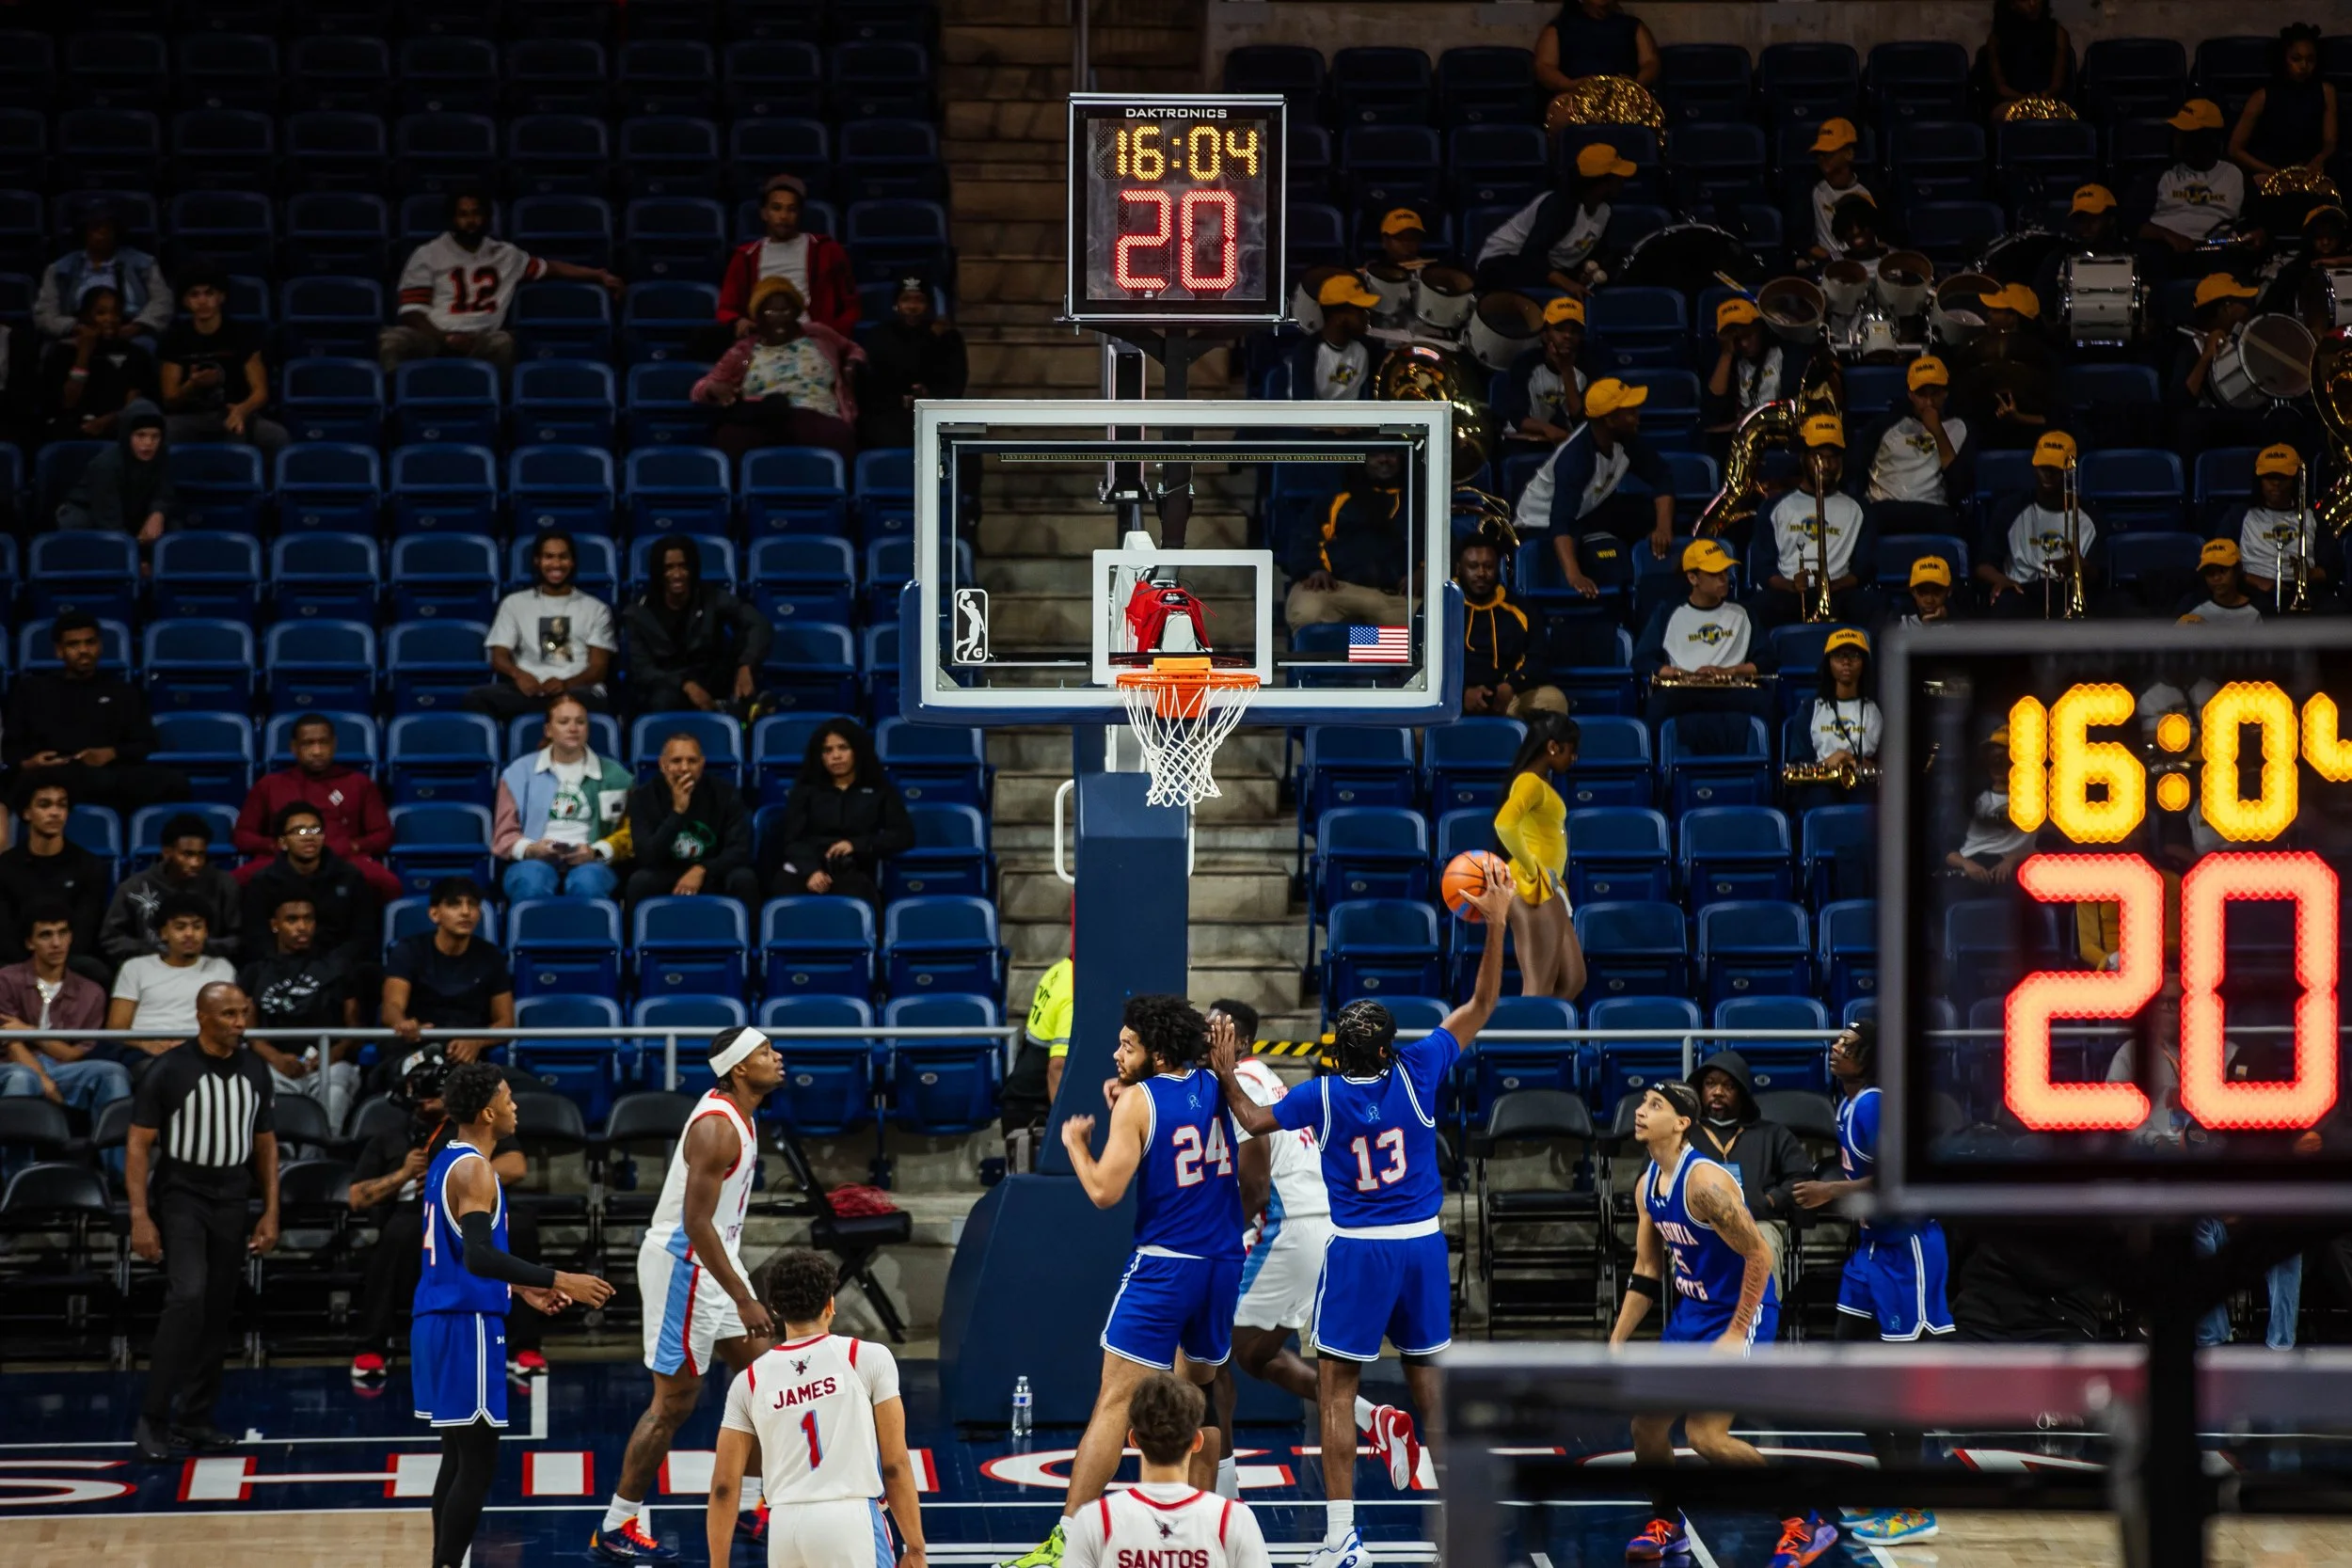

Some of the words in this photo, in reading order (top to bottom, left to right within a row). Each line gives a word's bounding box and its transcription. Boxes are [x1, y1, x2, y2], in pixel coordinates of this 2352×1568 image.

[1125, 108, 1228, 119] DAKTRONICS
[1117, 126, 1258, 181] 16:04
[1116, 190, 1236, 290] 20
[448, 266, 499, 314] 12
[973, 647, 983, 658] G
[2005, 851, 2339, 1130] 20
[1172, 1116, 1232, 1188] 24
[1351, 1127, 1407, 1192] 13
[423, 1201, 437, 1267] 4
[773, 1376, 837, 1410] JAMES
[800, 1408, 824, 1472] 1
[1118, 1549, 1210, 1568] SANTOS
